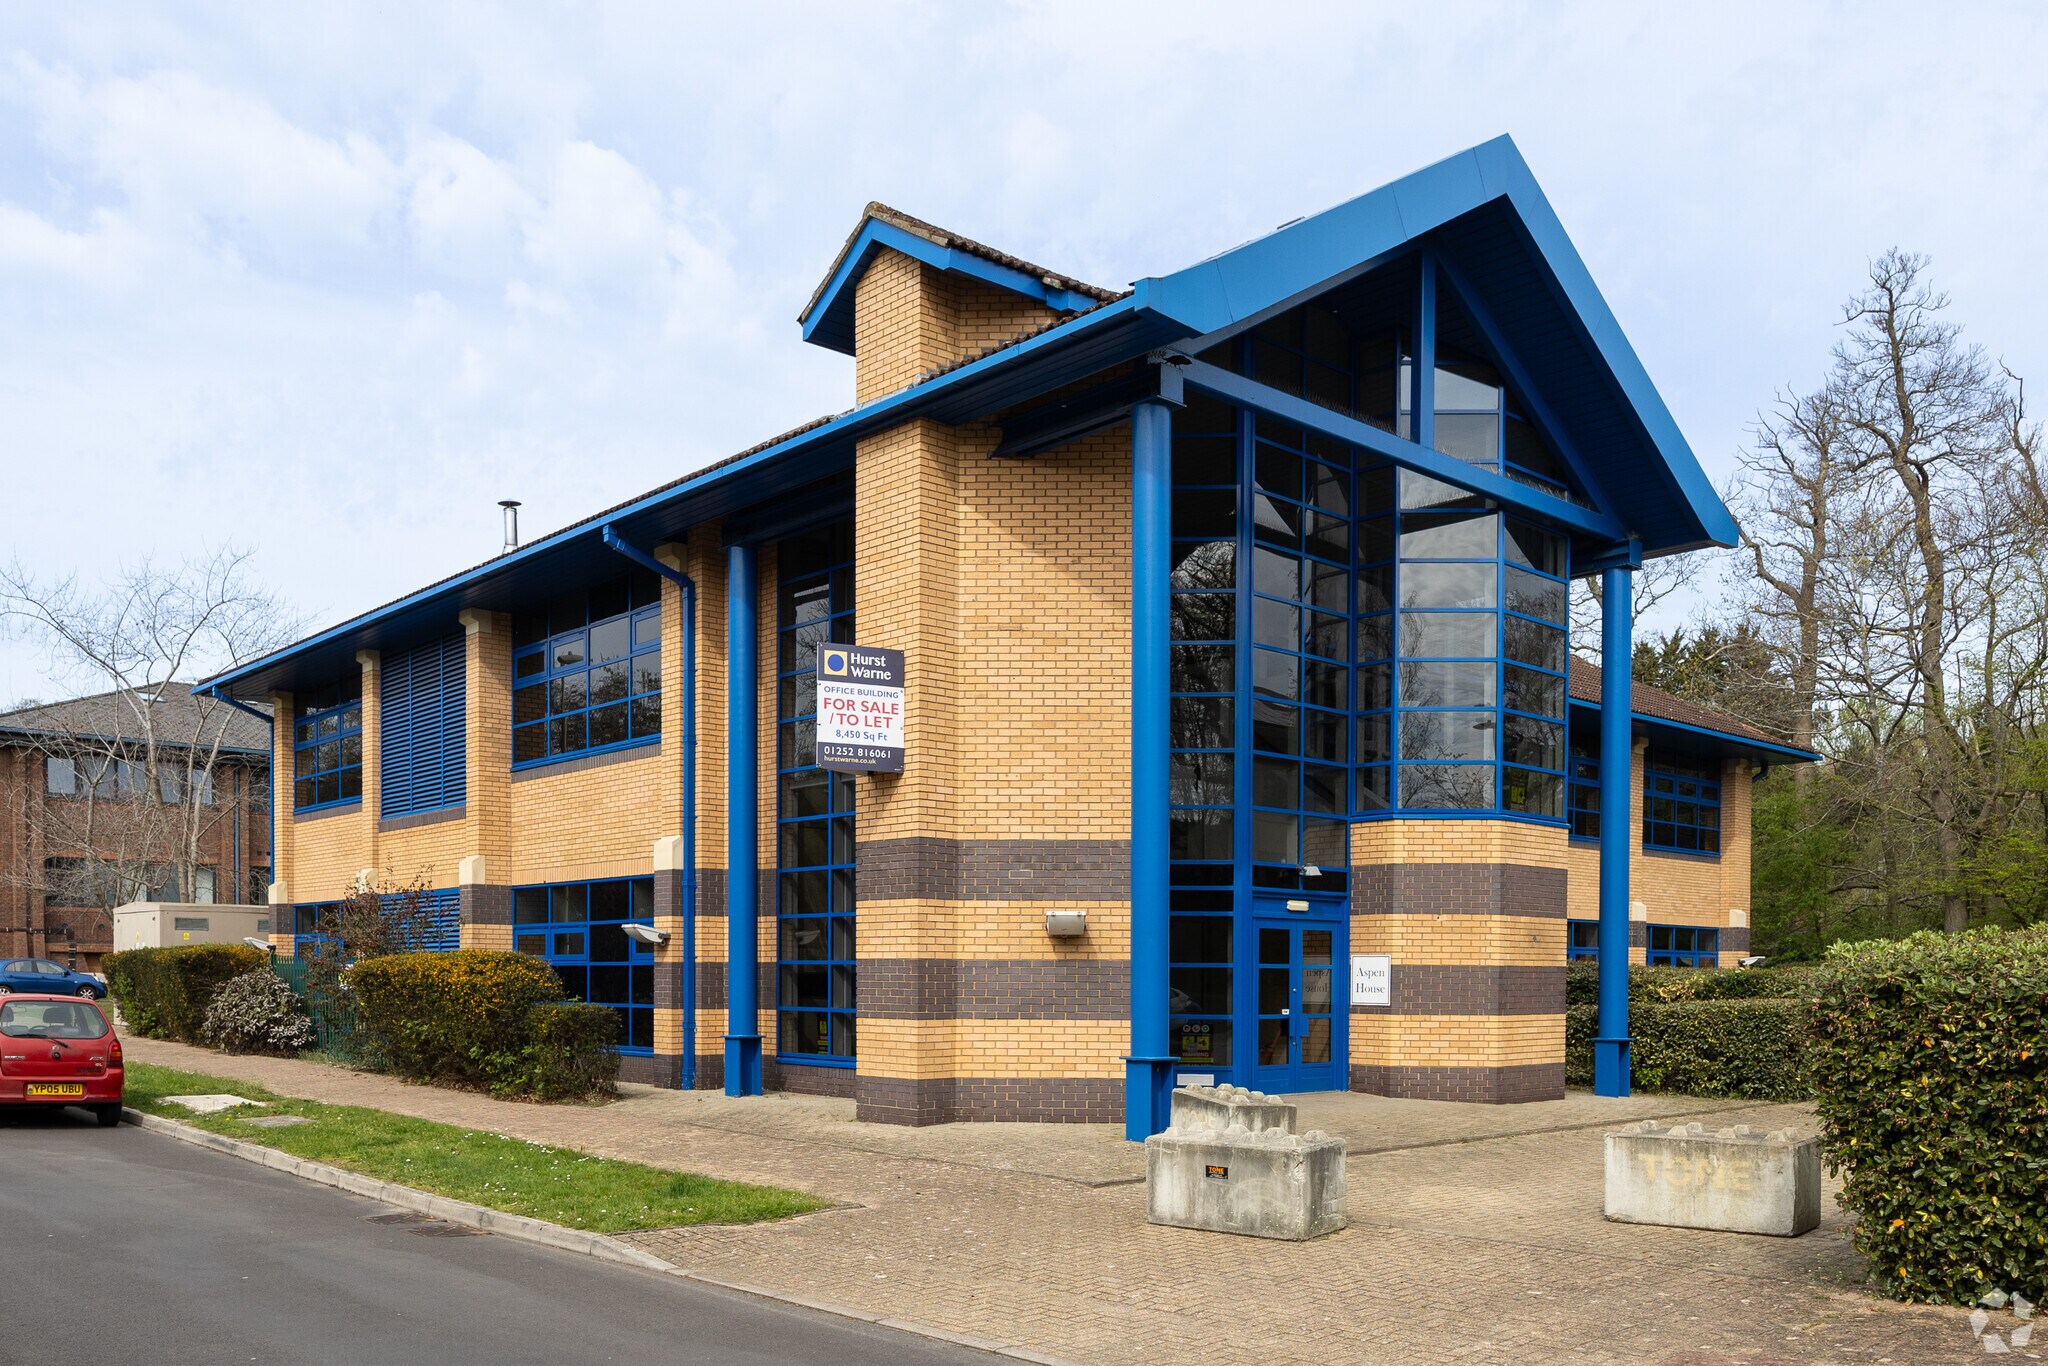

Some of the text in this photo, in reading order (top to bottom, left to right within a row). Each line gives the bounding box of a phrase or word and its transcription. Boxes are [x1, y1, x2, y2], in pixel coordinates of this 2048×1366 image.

[850, 653, 886, 667] Hurst
[850, 666, 892, 680] Warne
[824, 686, 899, 699] OFFICE BUILDING
[823, 697, 899, 715] FOR SALE
[864, 715, 893, 728] LET
[835, 729, 887, 742] 8,450 Sq Ft
[824, 746, 891, 758] 01252 816061
[824, 755, 876, 764] hurstwarne.co.uk
[1356, 967, 1385, 979] Aspen
[1356, 983, 1385, 993] House
[33, 1084, 81, 1093] YP05 UBU
[1638, 1154, 1753, 1191] TONE
